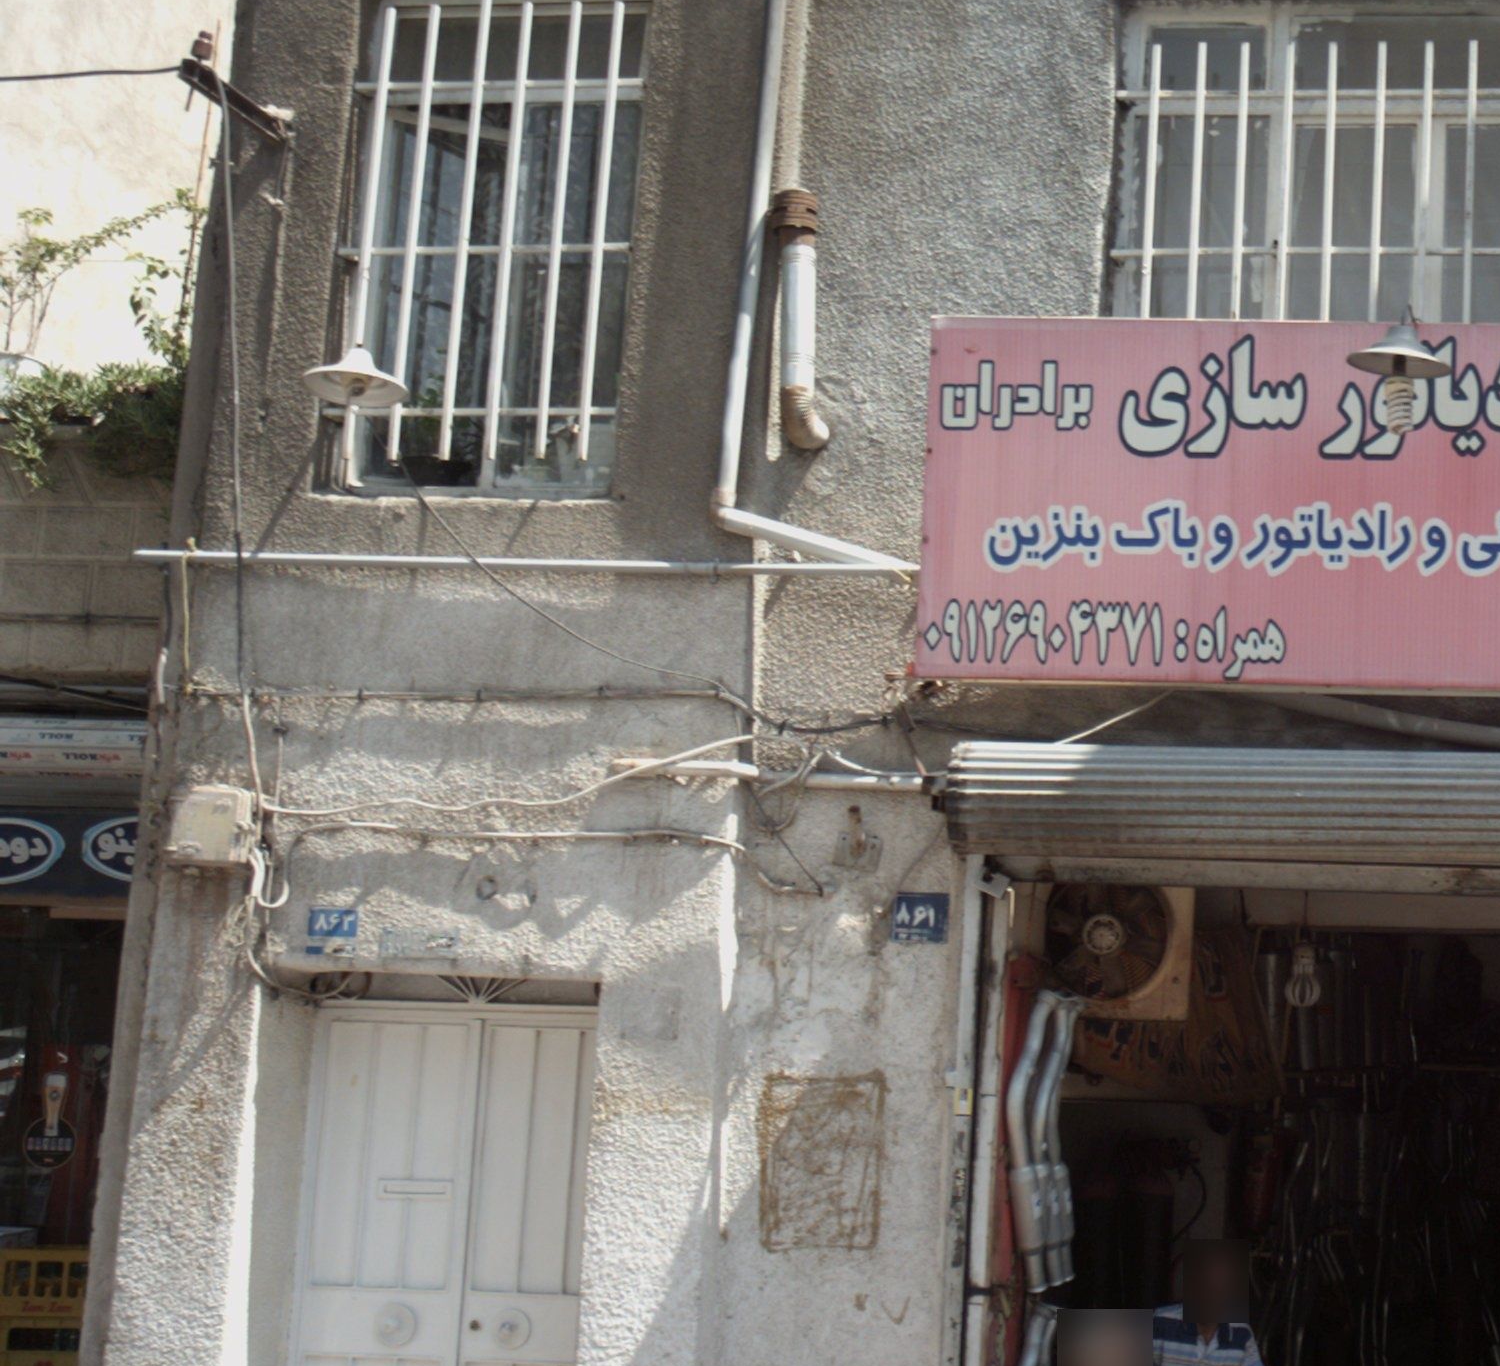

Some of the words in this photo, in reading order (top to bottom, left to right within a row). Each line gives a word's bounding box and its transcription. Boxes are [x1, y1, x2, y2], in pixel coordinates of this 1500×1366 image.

[940, 358, 1094, 432] برادران
[1119, 333, 1306, 459] سازی
[987, 509, 1103, 567] بنزین
[1114, 505, 1199, 560] باک
[1209, 520, 1235, 567] و
[1245, 507, 1412, 570] رادیاتور
[1421, 523, 1449, 570] و
[923, 598, 1164, 668] ۰۹۱۲۶۹۰۴۳۷۱
[895, 901, 936, 928] ۸۶۱
